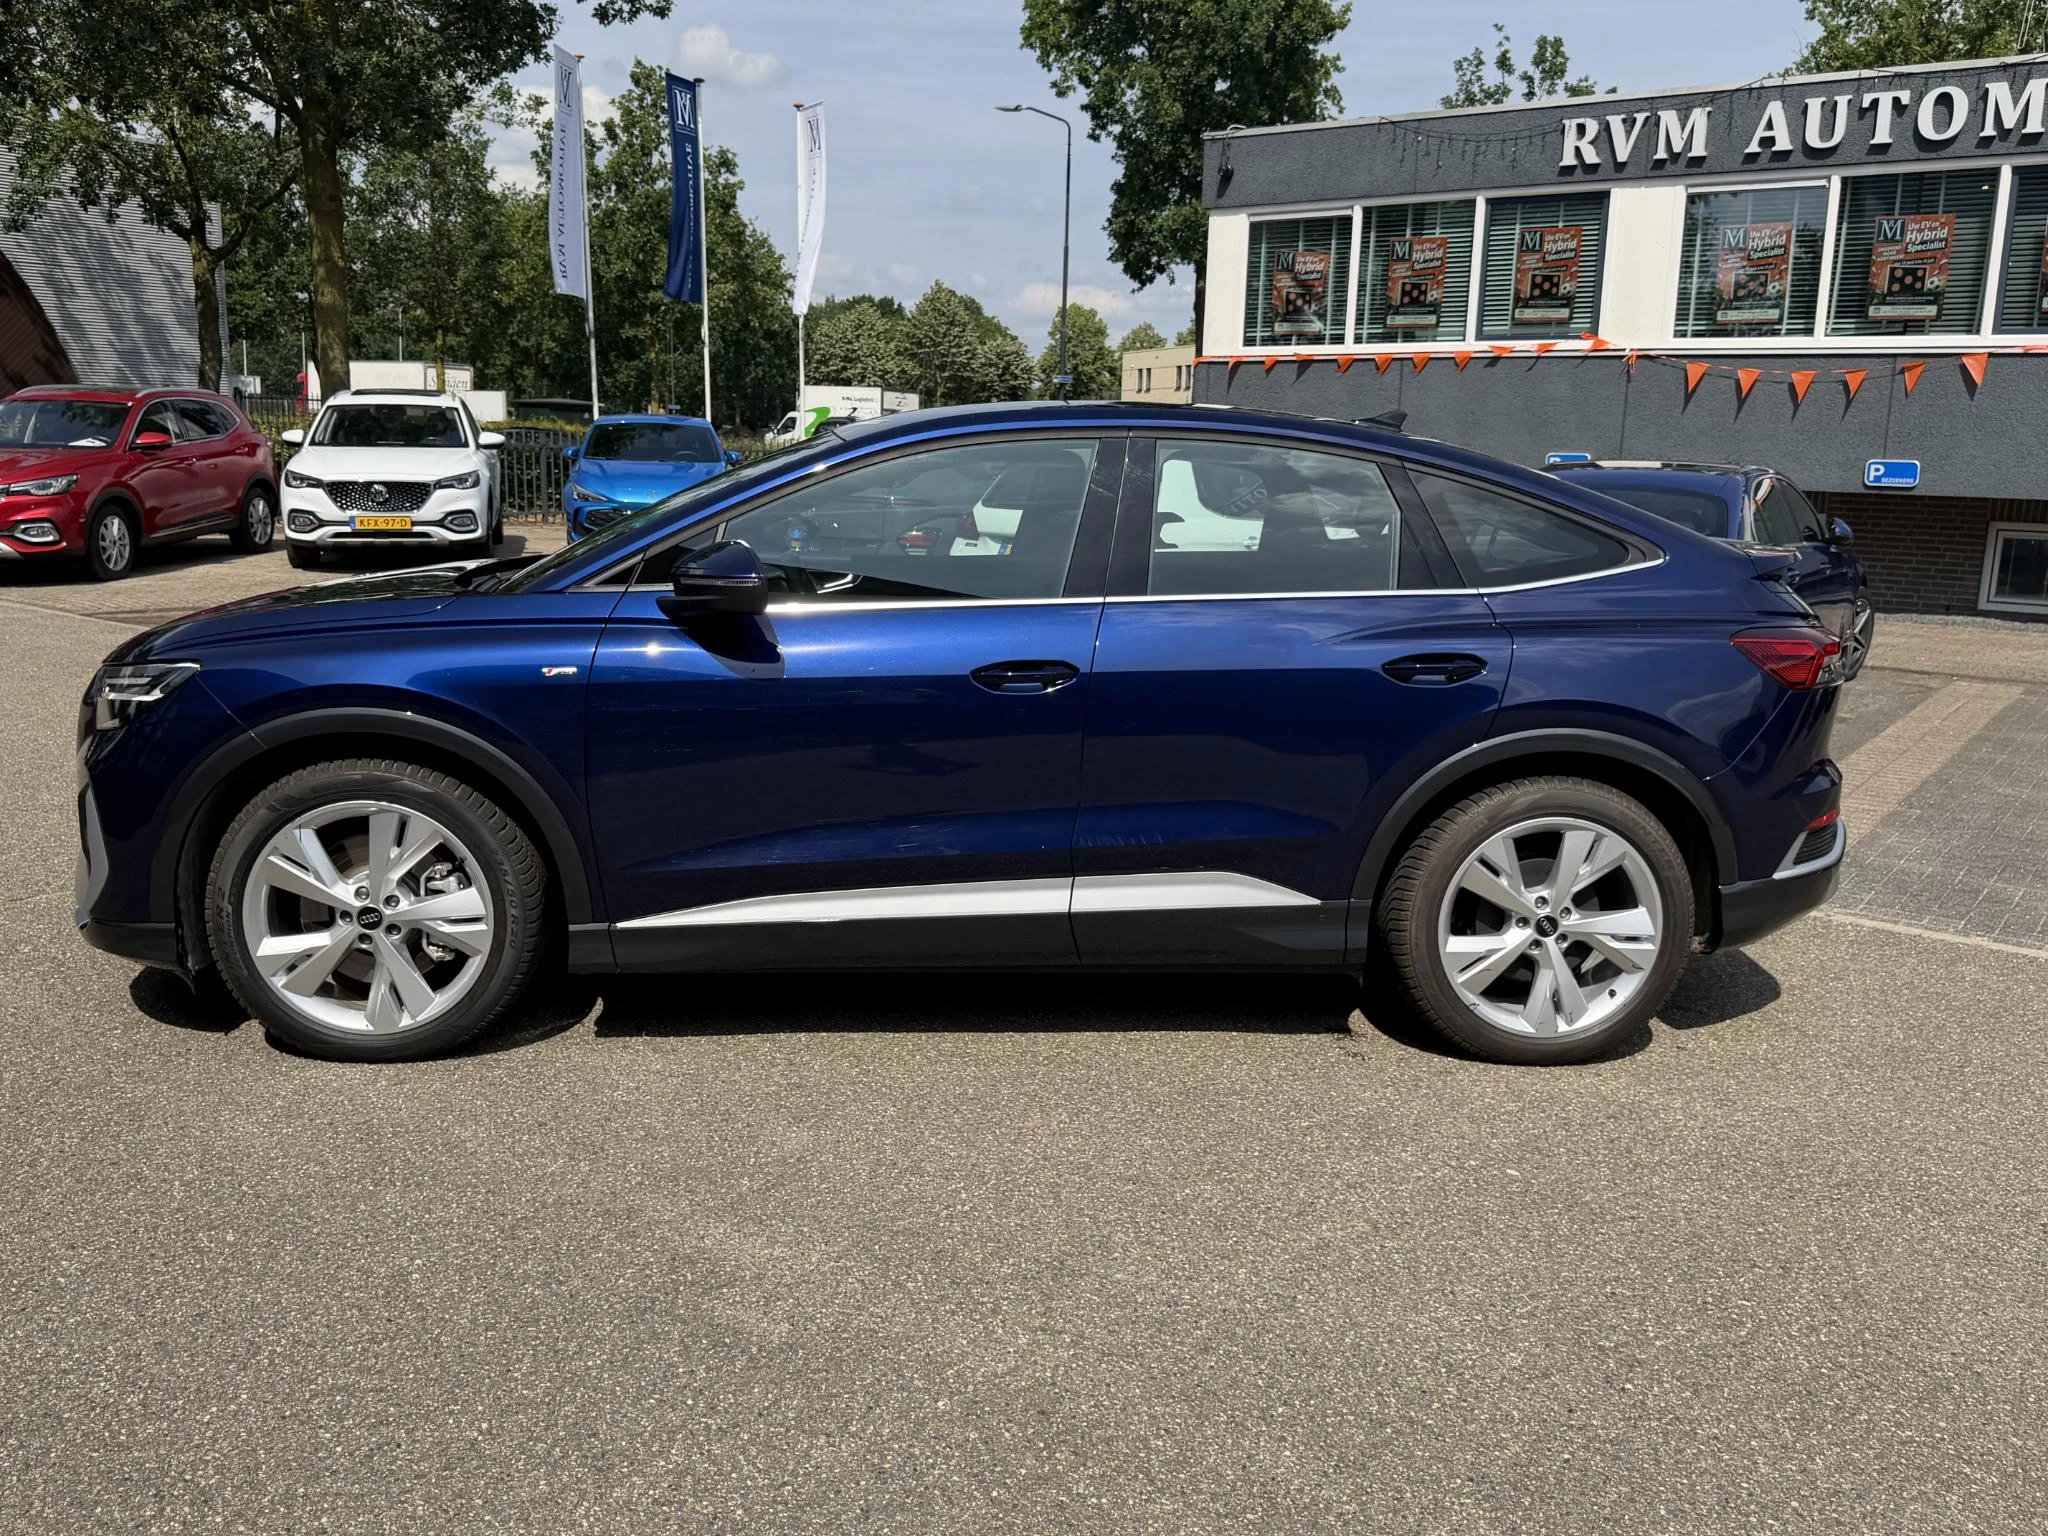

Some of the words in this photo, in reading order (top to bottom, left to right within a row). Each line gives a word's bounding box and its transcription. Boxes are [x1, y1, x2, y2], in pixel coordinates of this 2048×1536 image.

[1559, 107, 1712, 167] RVM
[1744, 78, 2048, 153] AUTOM
[1908, 222, 1920, 230] Uw
[1921, 221, 1931, 229] EV
[1906, 227, 1948, 243] Hybrid
[1544, 238, 1577, 253] Hybrid
[1749, 234, 1786, 250] Hybrid
[1907, 240, 1946, 253] Specialist
[1413, 248, 1443, 262] Hybrid
[1545, 251, 1576, 261] Specialist
[1750, 249, 1784, 259] Specialist
[1295, 261, 1324, 273] Hybrid
[1869, 464, 1885, 481] P
[360, 518, 407, 528] KFX-97-D
